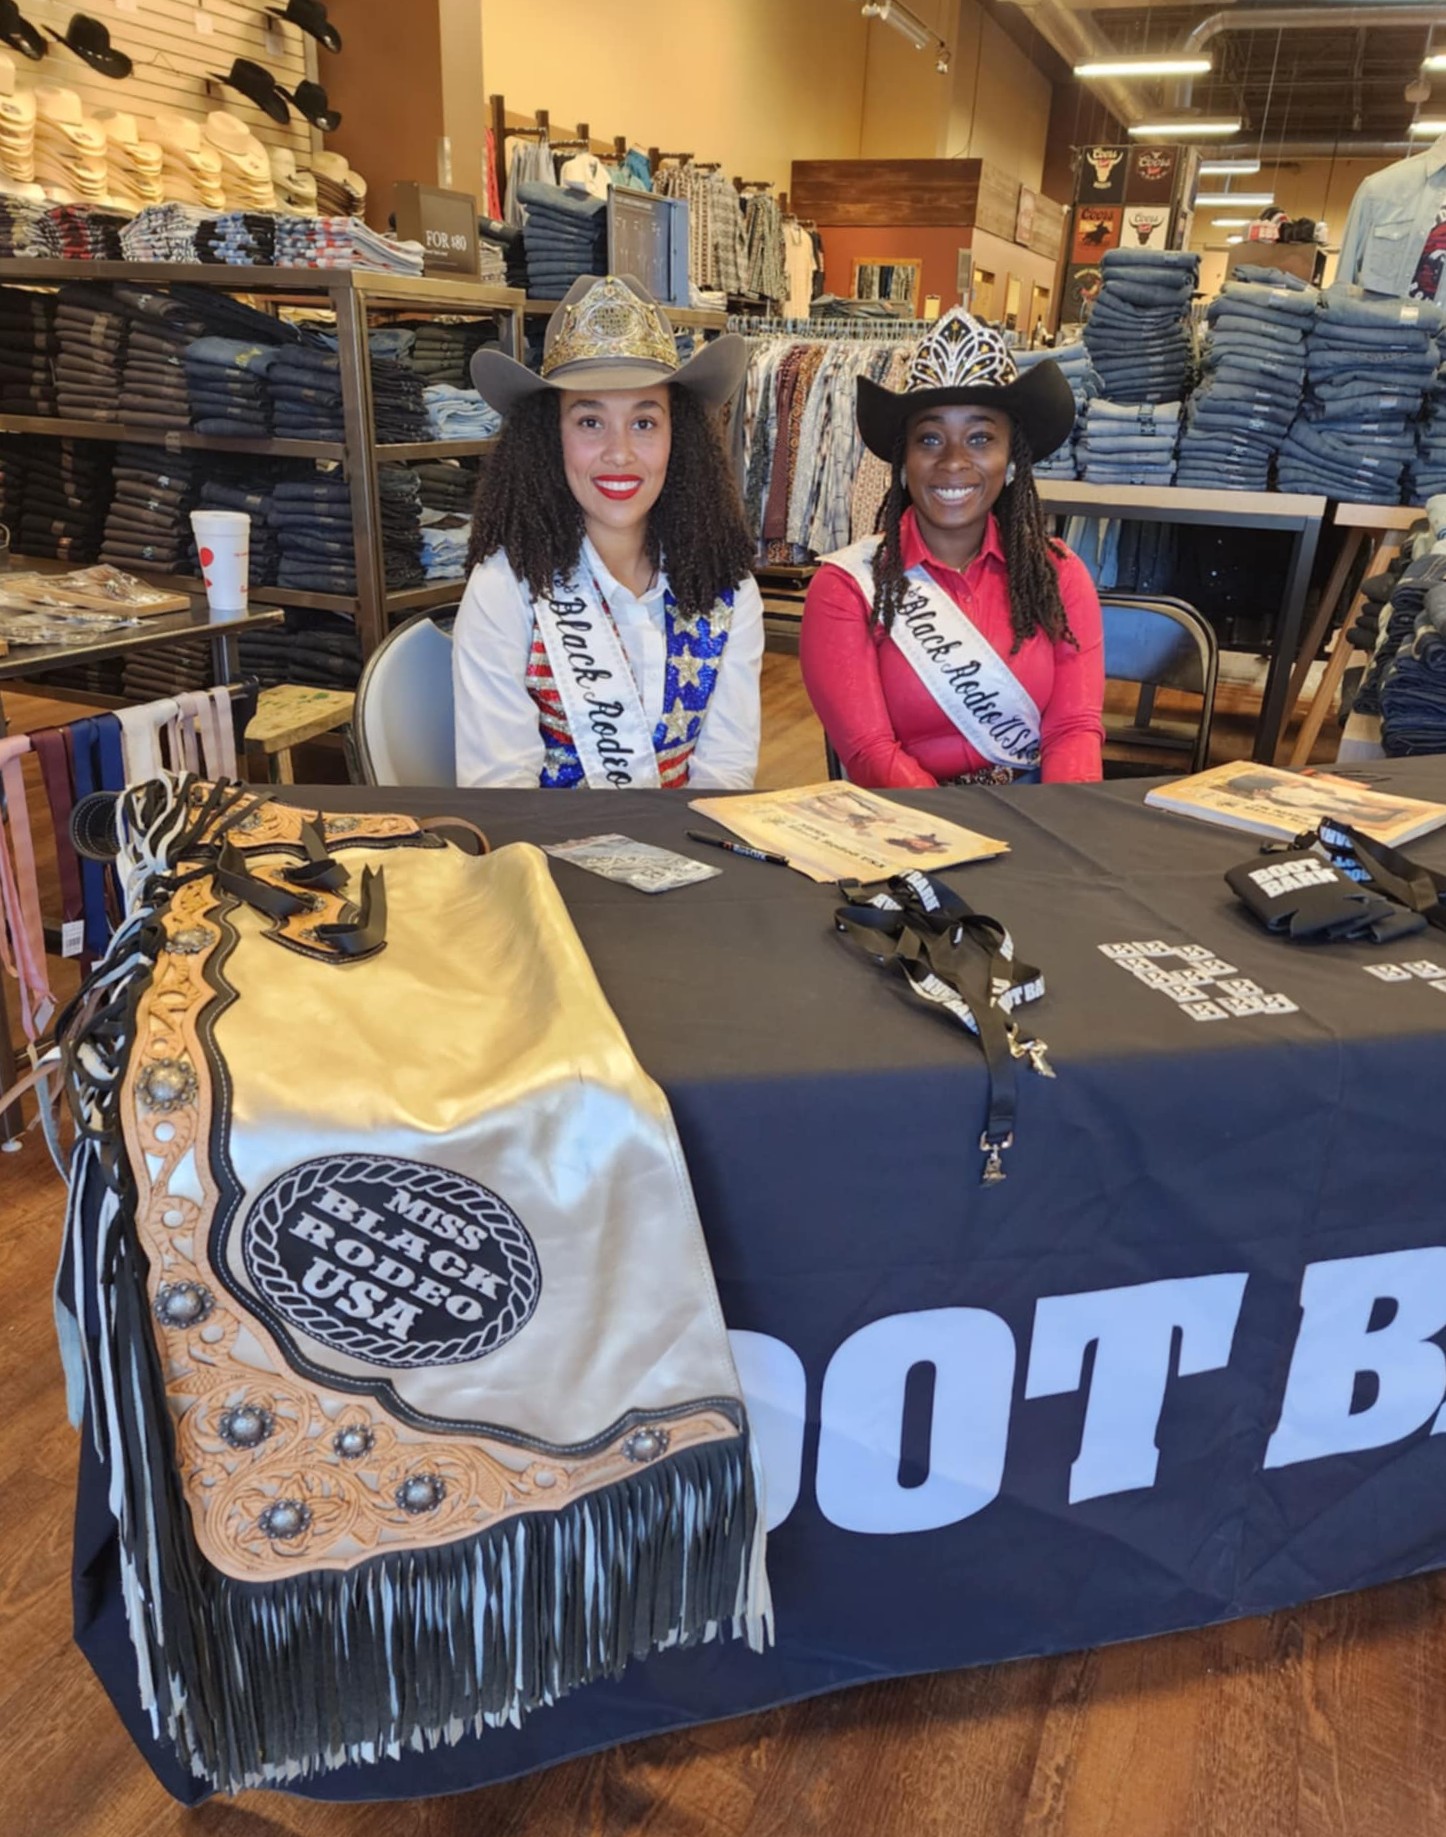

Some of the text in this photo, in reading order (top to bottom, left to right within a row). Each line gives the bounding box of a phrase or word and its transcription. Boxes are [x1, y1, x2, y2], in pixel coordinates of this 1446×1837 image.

[425, 229, 450, 249] FOR
[1081, 208, 1114, 220] Coors
[549, 597, 612, 690] Black
[583, 692, 634, 788] Rodeo
[894, 593, 963, 664] Black
[941, 660, 1003, 724] Rodeo
[1248, 857, 1324, 886] BOOT
[1259, 867, 1340, 899] BARN
[311, 1187, 509, 1300] BLACK
[382, 1188, 488, 1251] MISS
[288, 1212, 484, 1322] RODEO
[301, 1256, 424, 1341] USA
